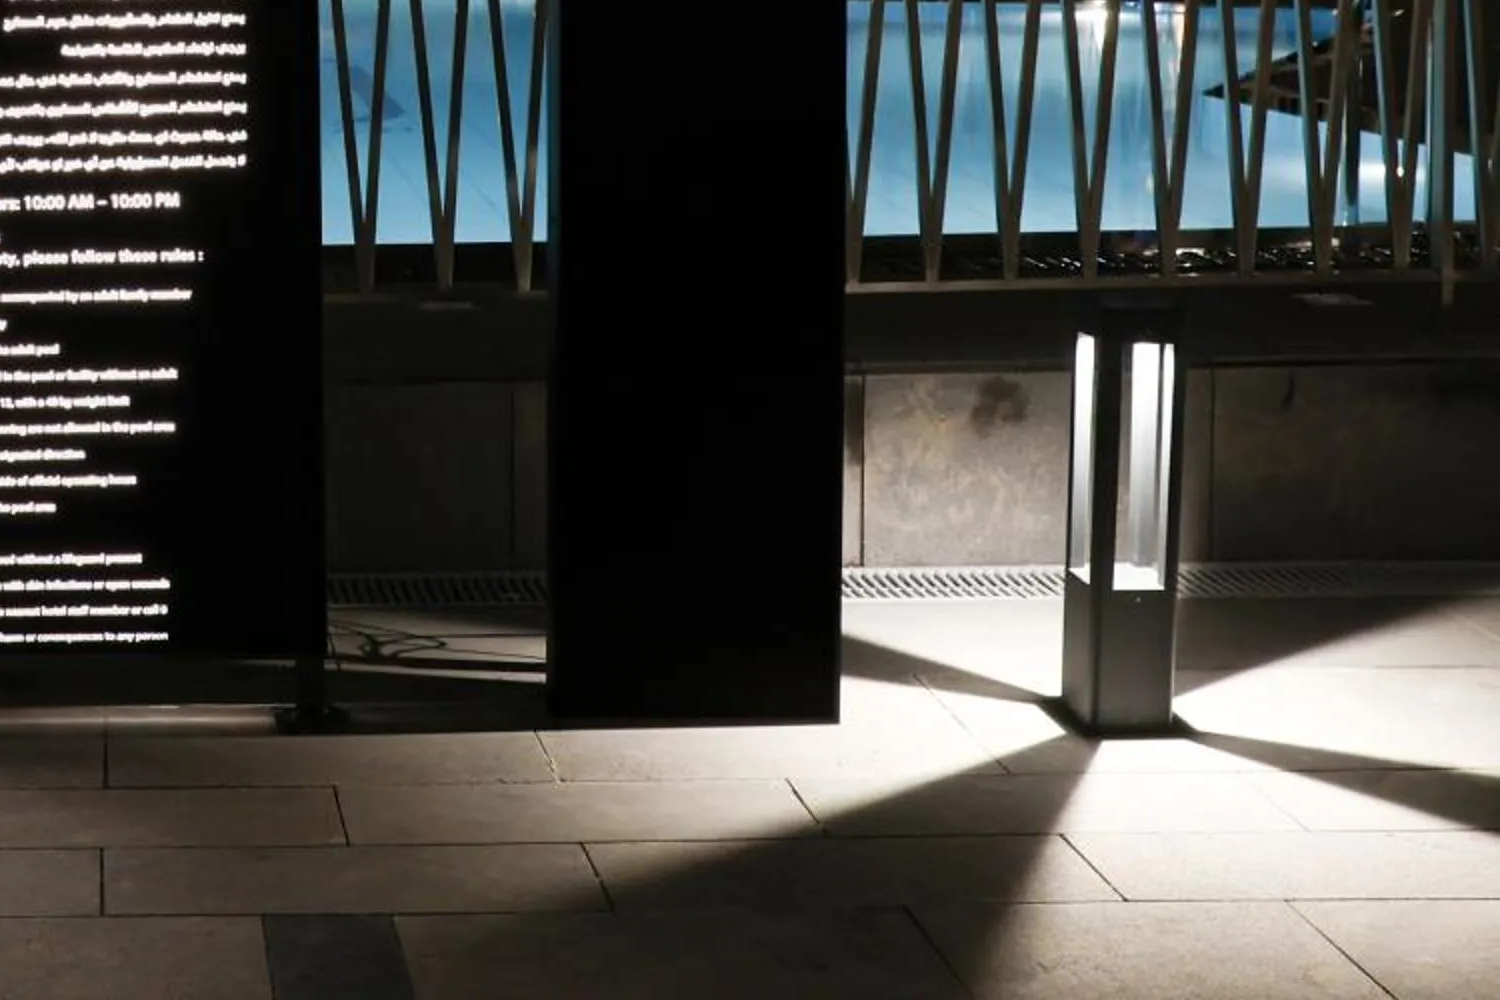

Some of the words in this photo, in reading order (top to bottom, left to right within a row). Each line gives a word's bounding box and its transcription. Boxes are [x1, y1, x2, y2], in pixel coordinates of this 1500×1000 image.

[24, 195, 65, 210] 10:00
[68, 194, 94, 209] AM
[111, 193, 152, 208] 10:00
[155, 192, 180, 207] PM
